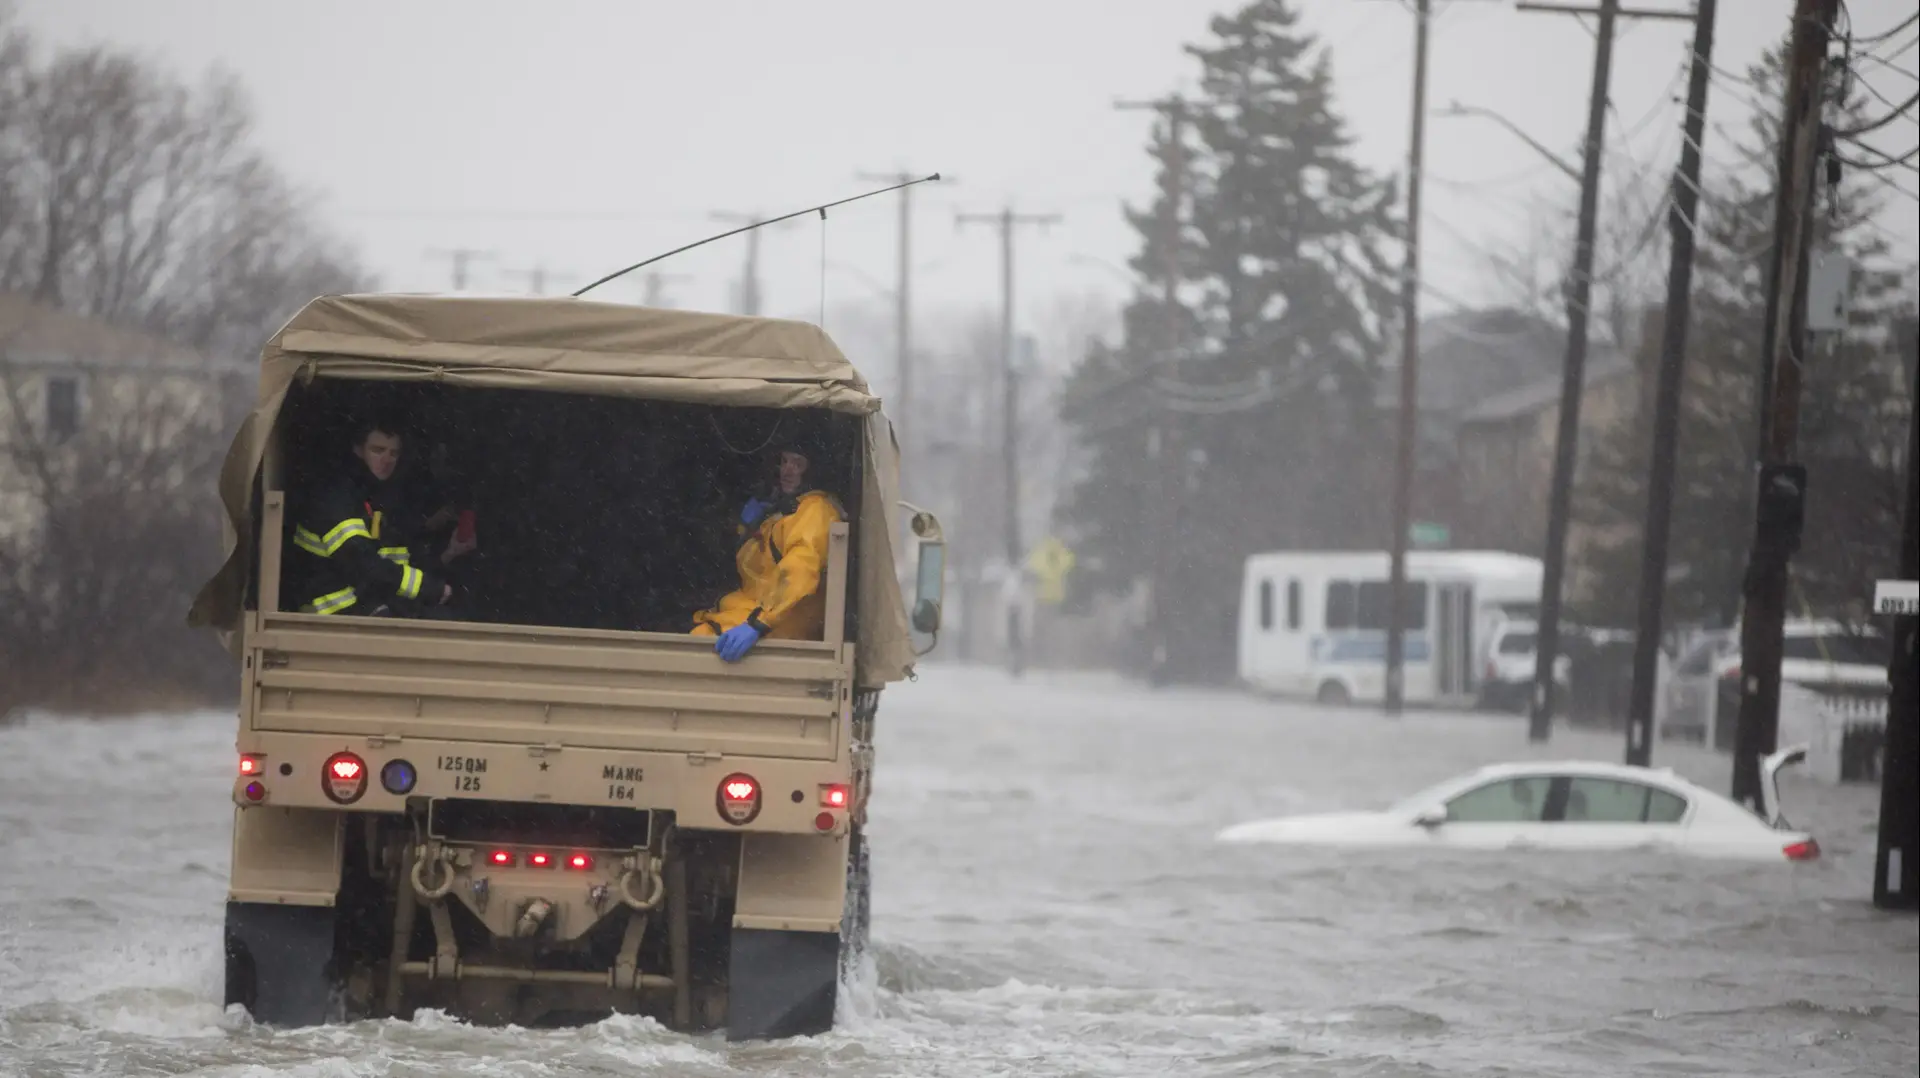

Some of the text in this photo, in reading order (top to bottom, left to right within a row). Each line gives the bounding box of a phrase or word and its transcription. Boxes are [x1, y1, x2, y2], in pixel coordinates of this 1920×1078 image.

[438, 755, 487, 773] 125QM
[455, 775, 481, 791] 125
[608, 784, 635, 800] 164
